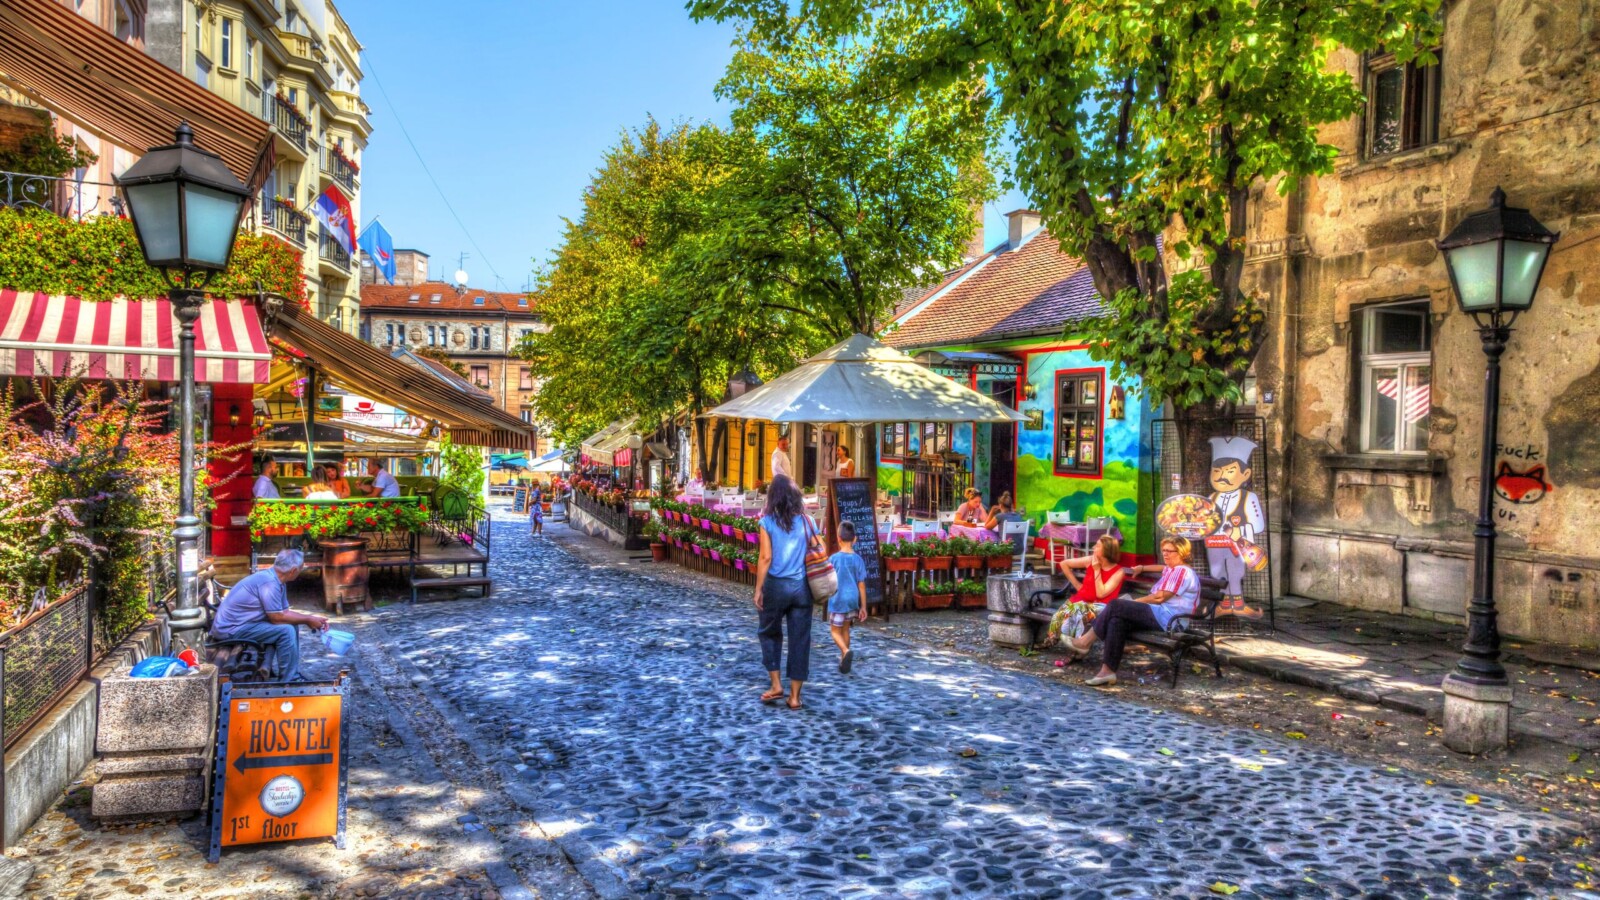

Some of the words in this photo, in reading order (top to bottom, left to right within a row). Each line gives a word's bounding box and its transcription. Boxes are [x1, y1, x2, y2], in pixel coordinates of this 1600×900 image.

[1496, 444, 1539, 460] Fuck
[249, 718, 331, 753] HOSTEL
[230, 815, 250, 841] 1st
[262, 818, 299, 839] floor
